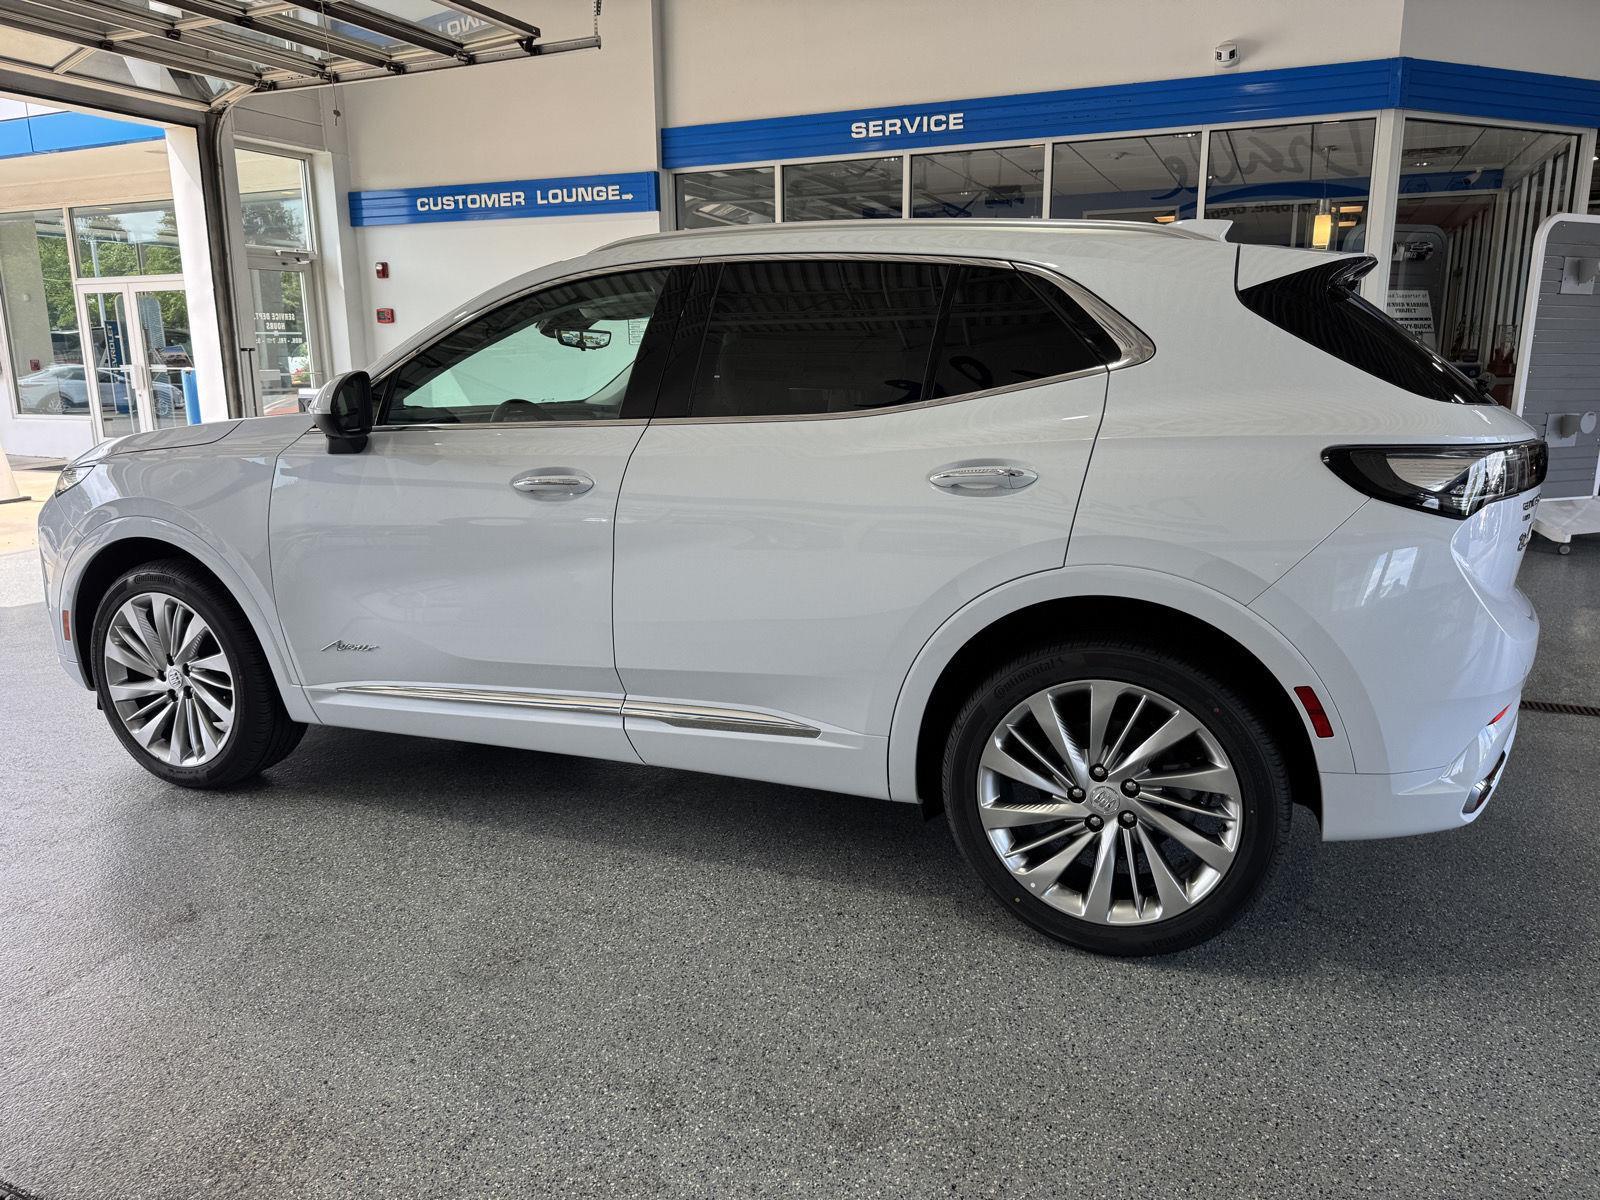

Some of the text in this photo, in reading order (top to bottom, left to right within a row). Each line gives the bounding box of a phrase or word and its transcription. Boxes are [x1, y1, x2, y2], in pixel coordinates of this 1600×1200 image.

[850, 112, 964, 139] SERVICE
[416, 185, 620, 212] CUSTOMER LOUNGE
[994, 659, 1055, 698] Continental
